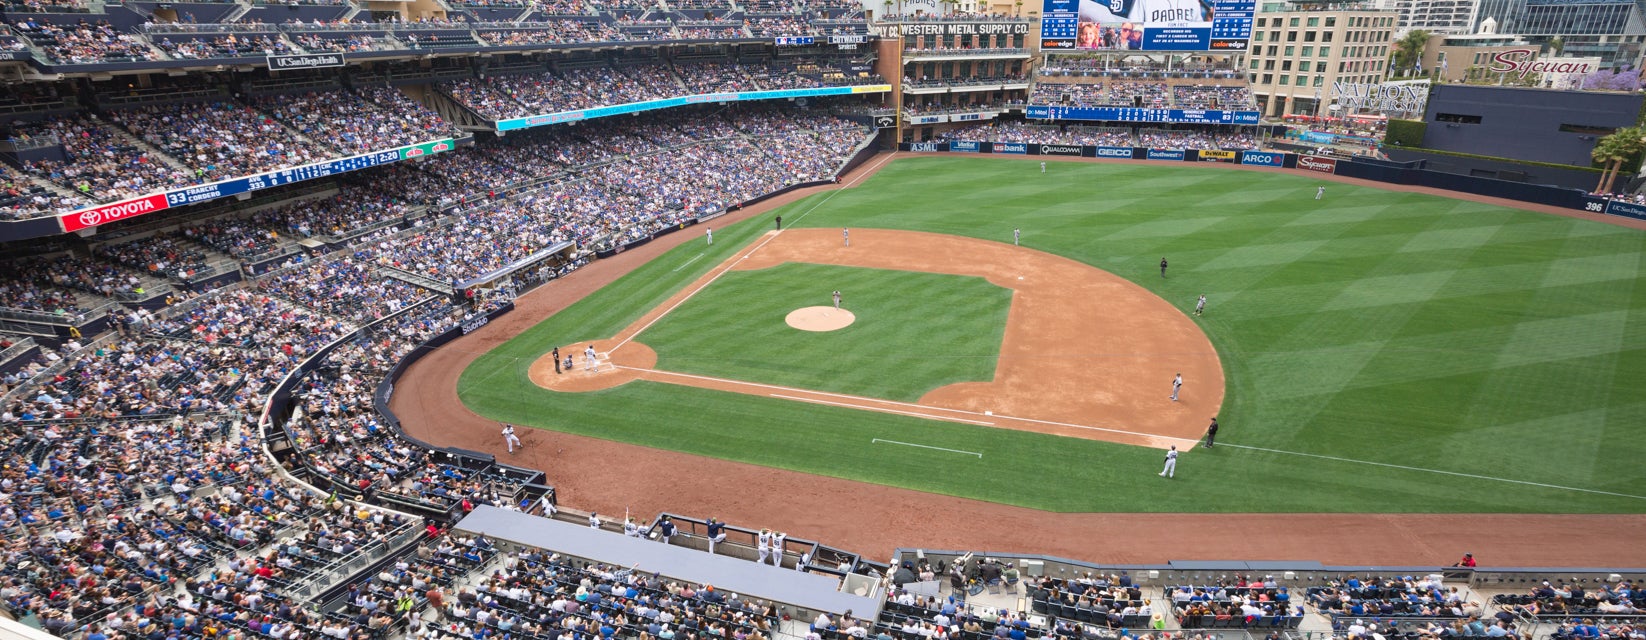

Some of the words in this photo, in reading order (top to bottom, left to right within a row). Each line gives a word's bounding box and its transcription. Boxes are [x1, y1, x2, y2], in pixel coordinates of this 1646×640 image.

[901, 25, 944, 34] WESTERN
[948, 24, 977, 34] METAL
[979, 24, 1012, 34] SUPPLY
[1015, 24, 1029, 34] CO.
[1490, 49, 1590, 79] Sycuan
[911, 143, 937, 152] ASML
[1042, 146, 1080, 154] QUALCOMM
[380, 152, 398, 162] 2:20
[1244, 154, 1272, 163] ARCO
[1301, 156, 1330, 169] Sycuan
[248, 182, 265, 191] .333
[169, 192, 186, 204] 33
[186, 185, 218, 196] FRANCHY
[188, 191, 221, 202] CORDERO
[101, 200, 154, 219] TOYOTA
[1585, 202, 1603, 211] 396
[462, 317, 488, 335] StubHub
